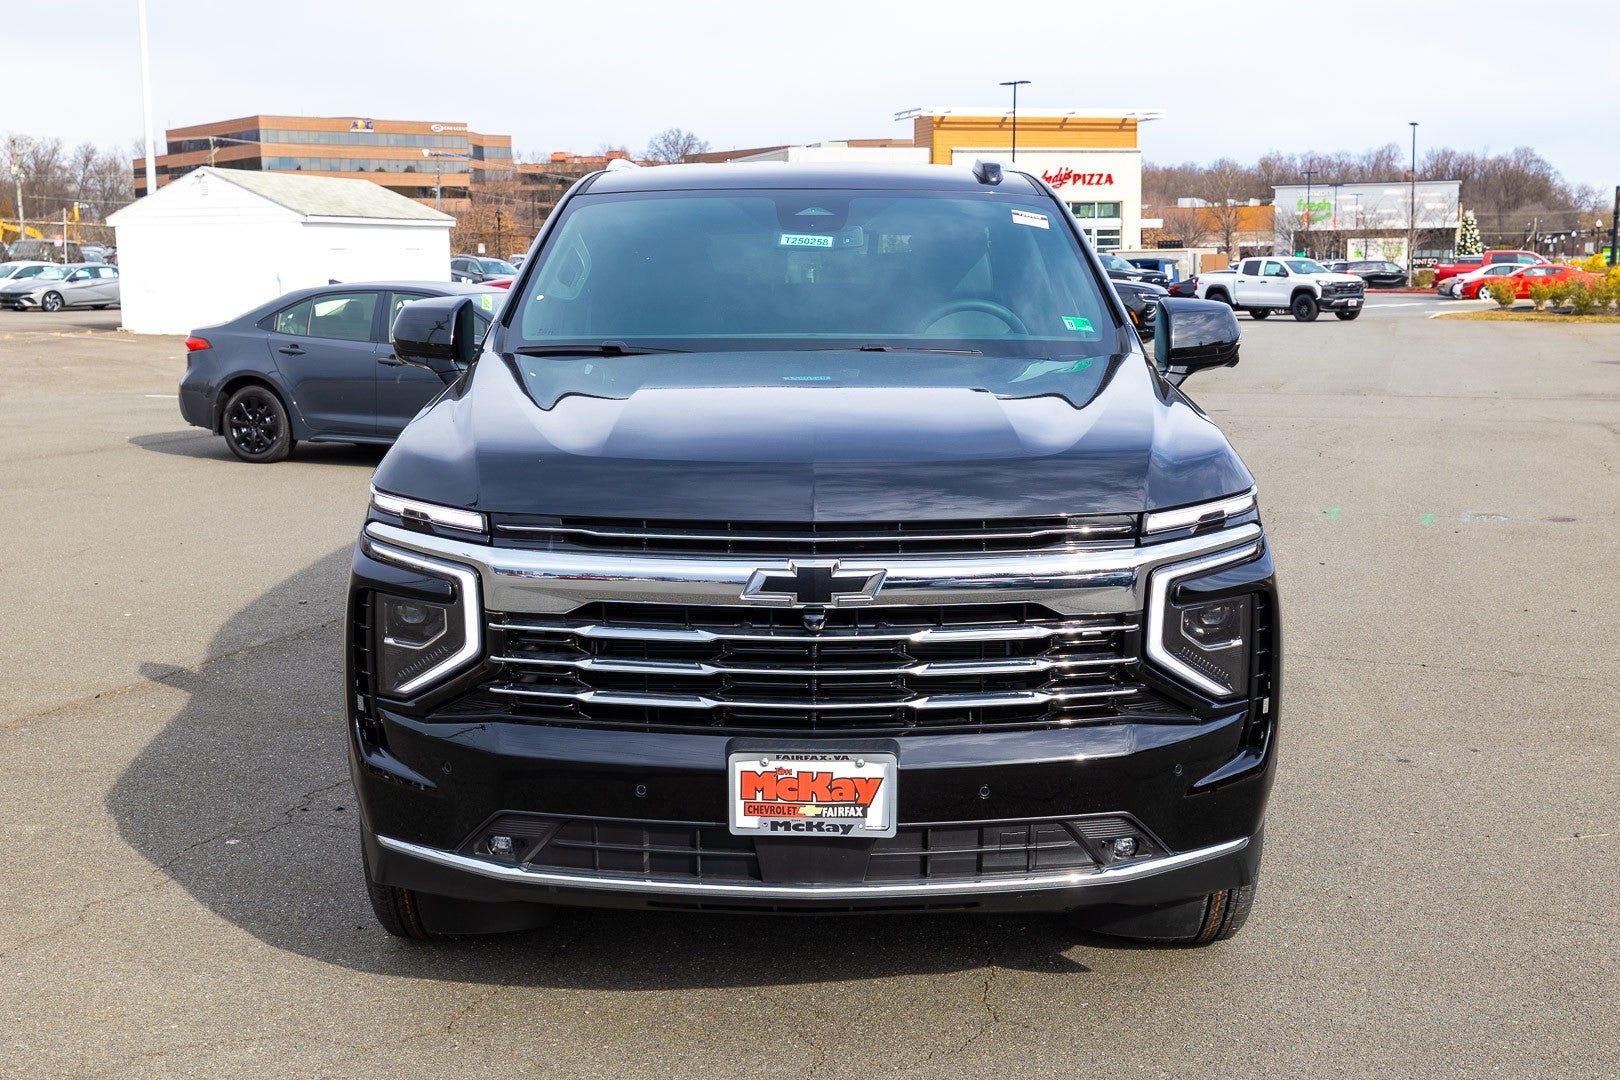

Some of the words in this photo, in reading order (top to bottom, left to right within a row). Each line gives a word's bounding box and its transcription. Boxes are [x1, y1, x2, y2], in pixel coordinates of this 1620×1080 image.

[1073, 173, 1114, 185] PIZZA
[784, 236, 829, 246] T250258
[740, 770, 884, 808] McKay
[747, 804, 798, 816] CHEVROLET
[822, 806, 864, 818] FAIRFAX
[770, 820, 855, 836] McKay
